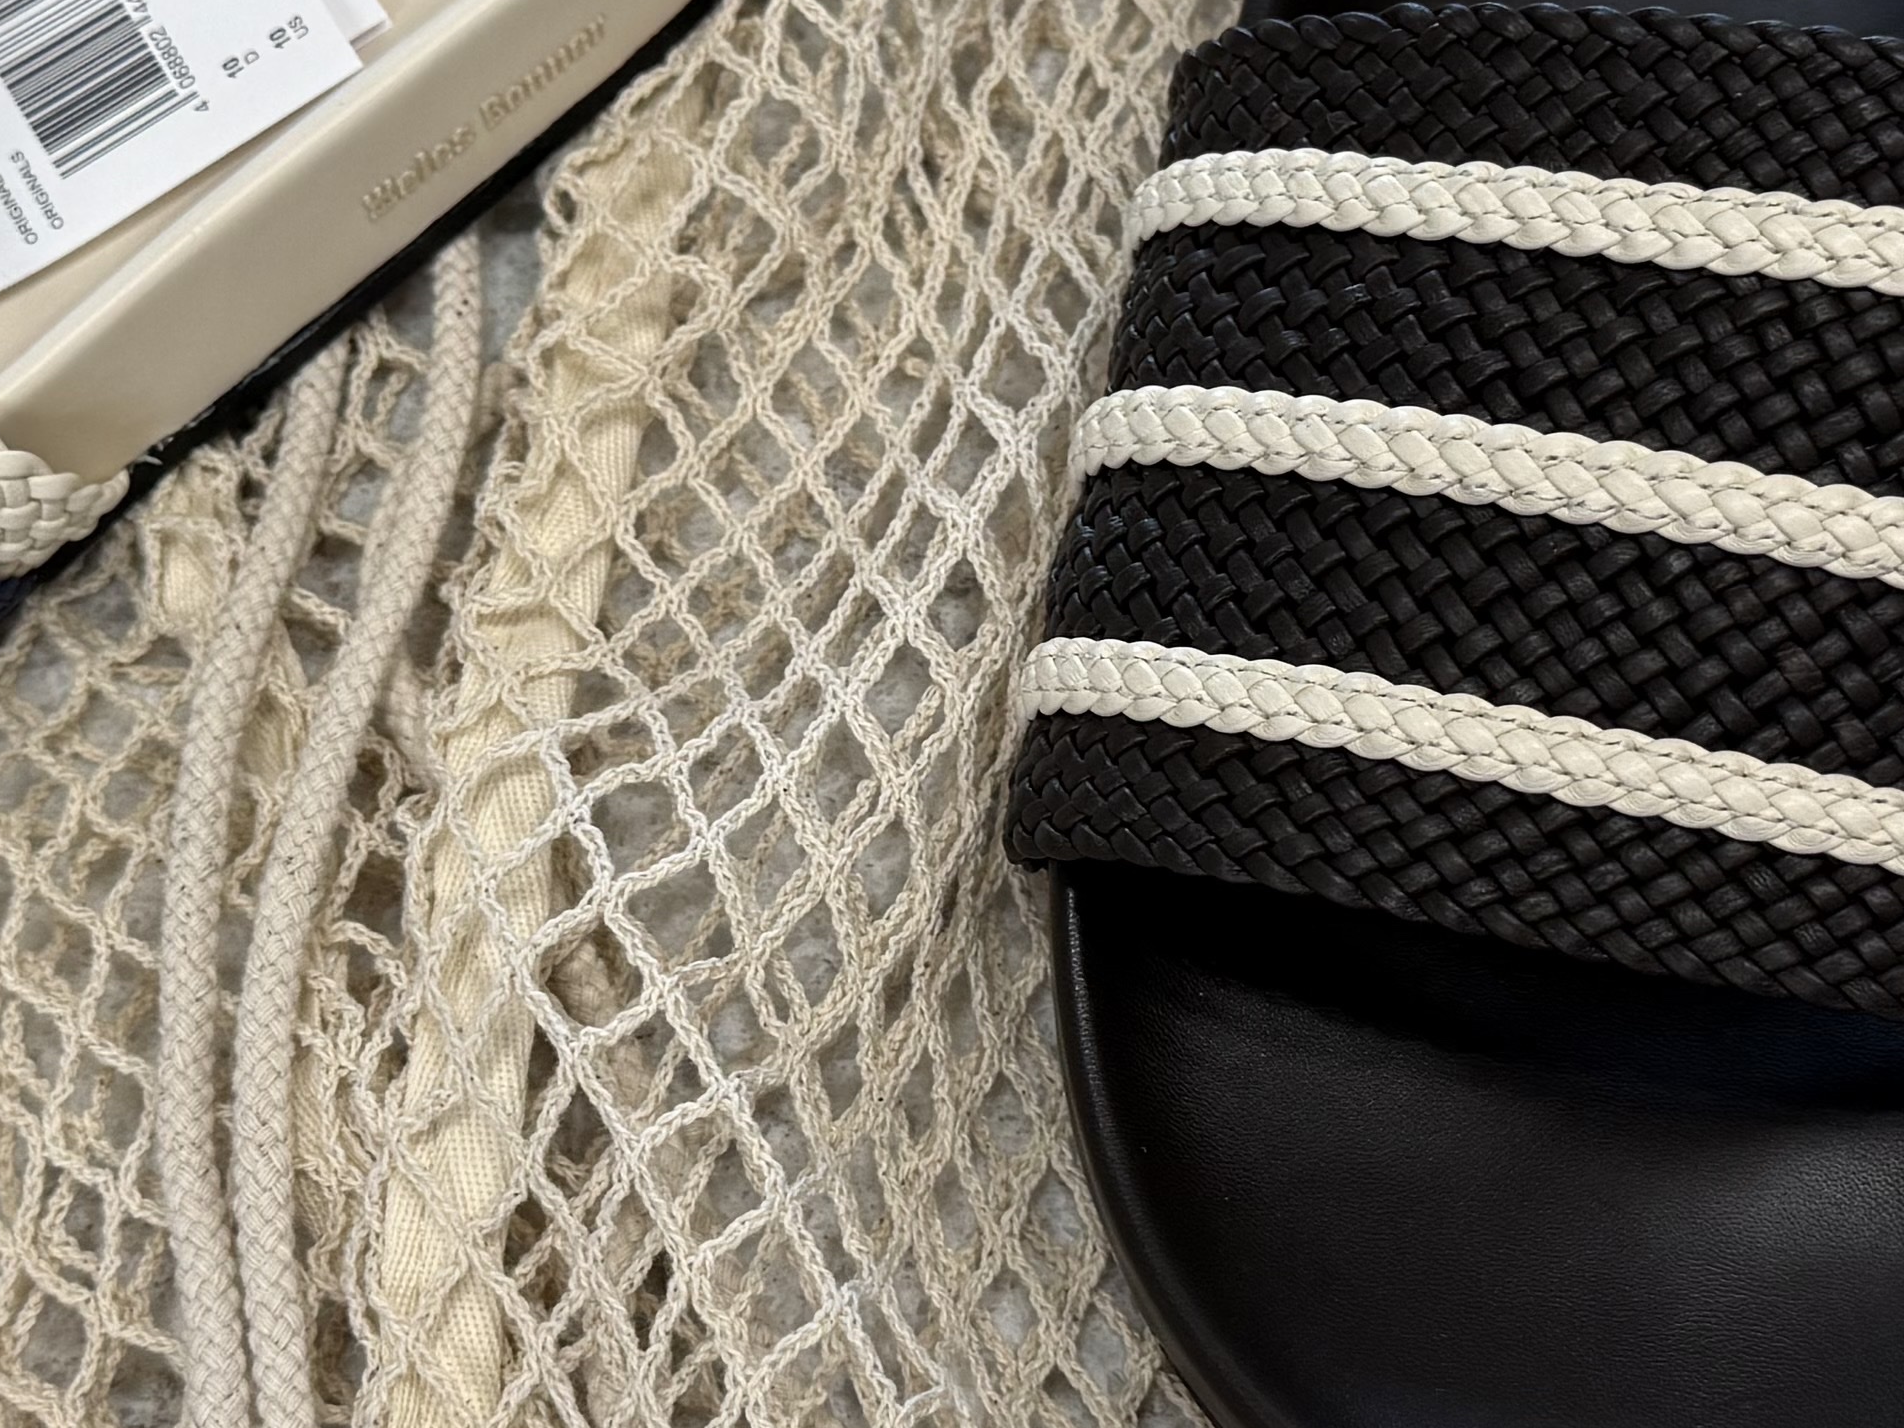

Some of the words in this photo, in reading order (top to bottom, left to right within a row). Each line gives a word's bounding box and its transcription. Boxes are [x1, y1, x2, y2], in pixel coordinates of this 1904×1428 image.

[268, 26, 292, 50] 10
[287, 14, 310, 41] US
[148, 23, 197, 91] 068802
[221, 55, 246, 80] 10
[243, 49, 261, 66] D
[193, 99, 211, 113] 4
[9, 150, 65, 230] ORIGINALS
